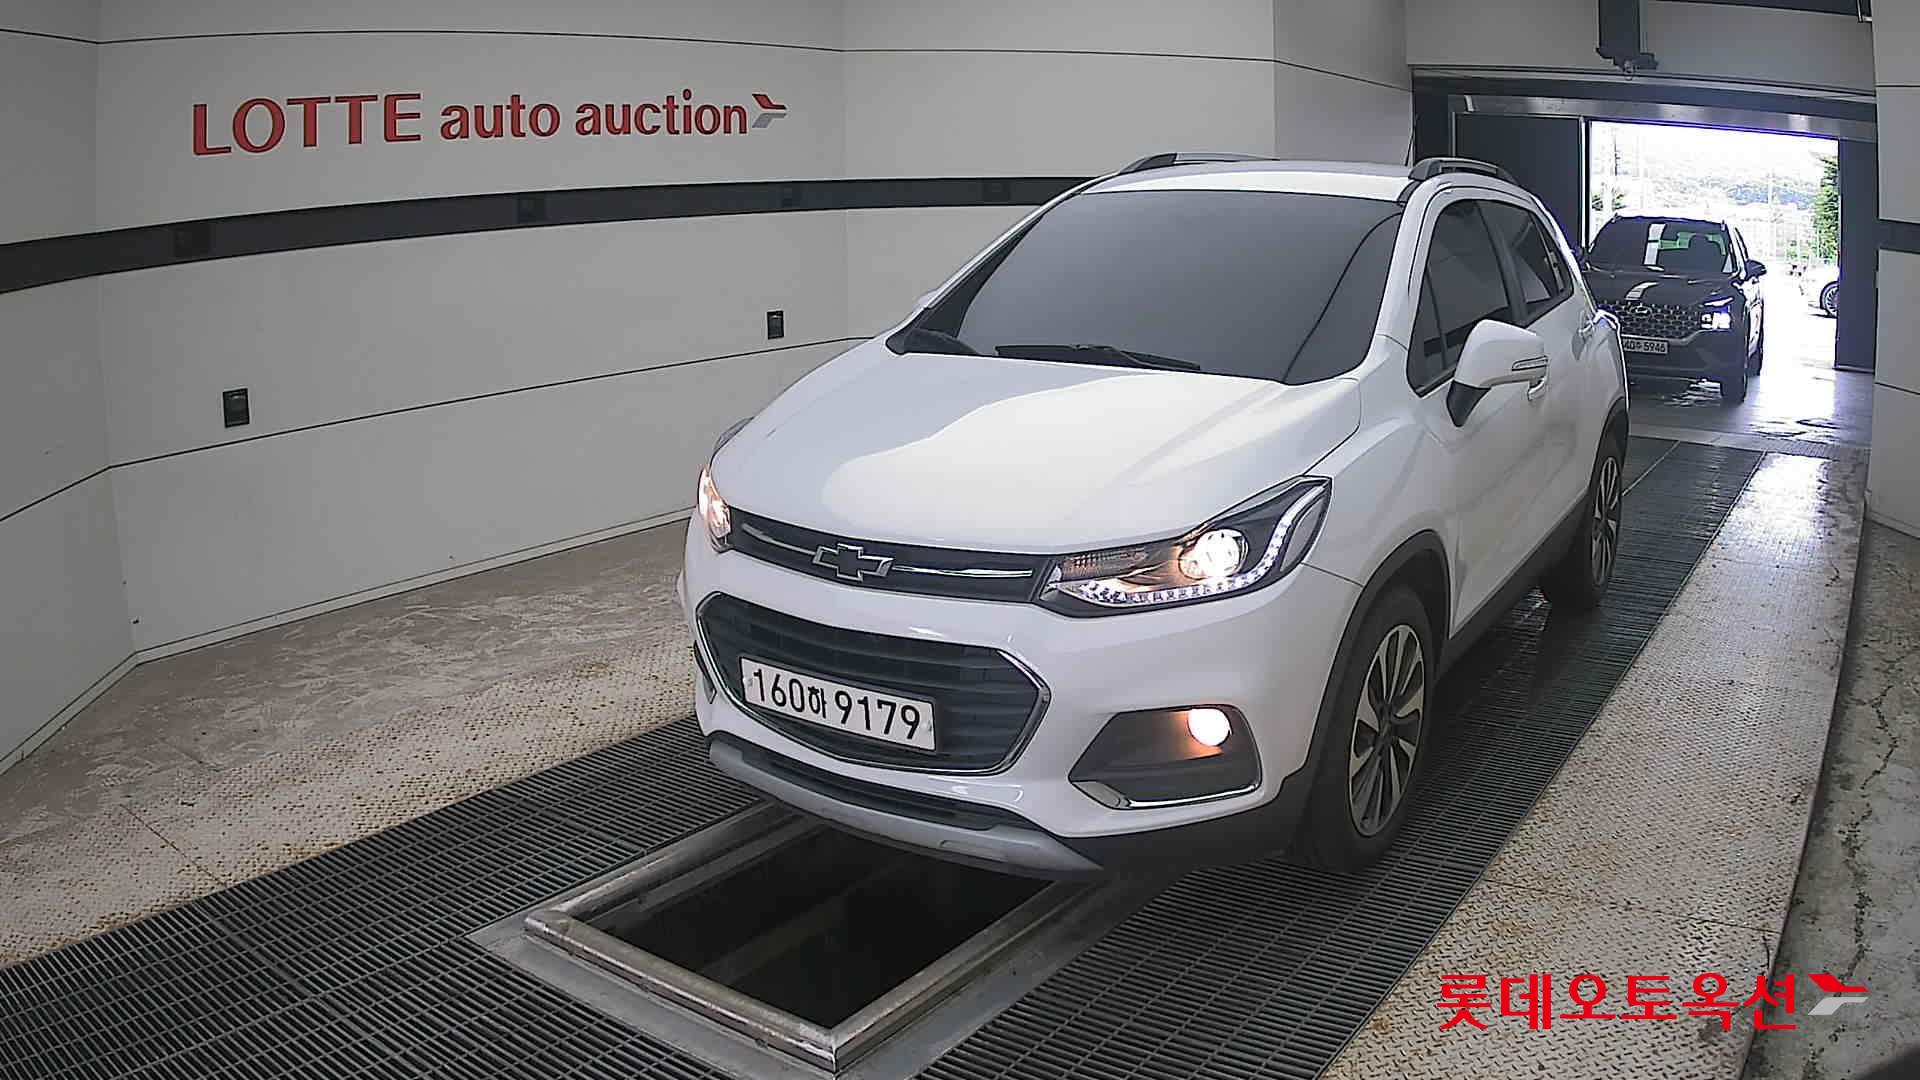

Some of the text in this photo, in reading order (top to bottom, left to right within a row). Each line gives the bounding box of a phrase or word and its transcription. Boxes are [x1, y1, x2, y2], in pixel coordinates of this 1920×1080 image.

[192, 89, 748, 156] LOTTE auto auction
[753, 668, 921, 739] 160하 9179
